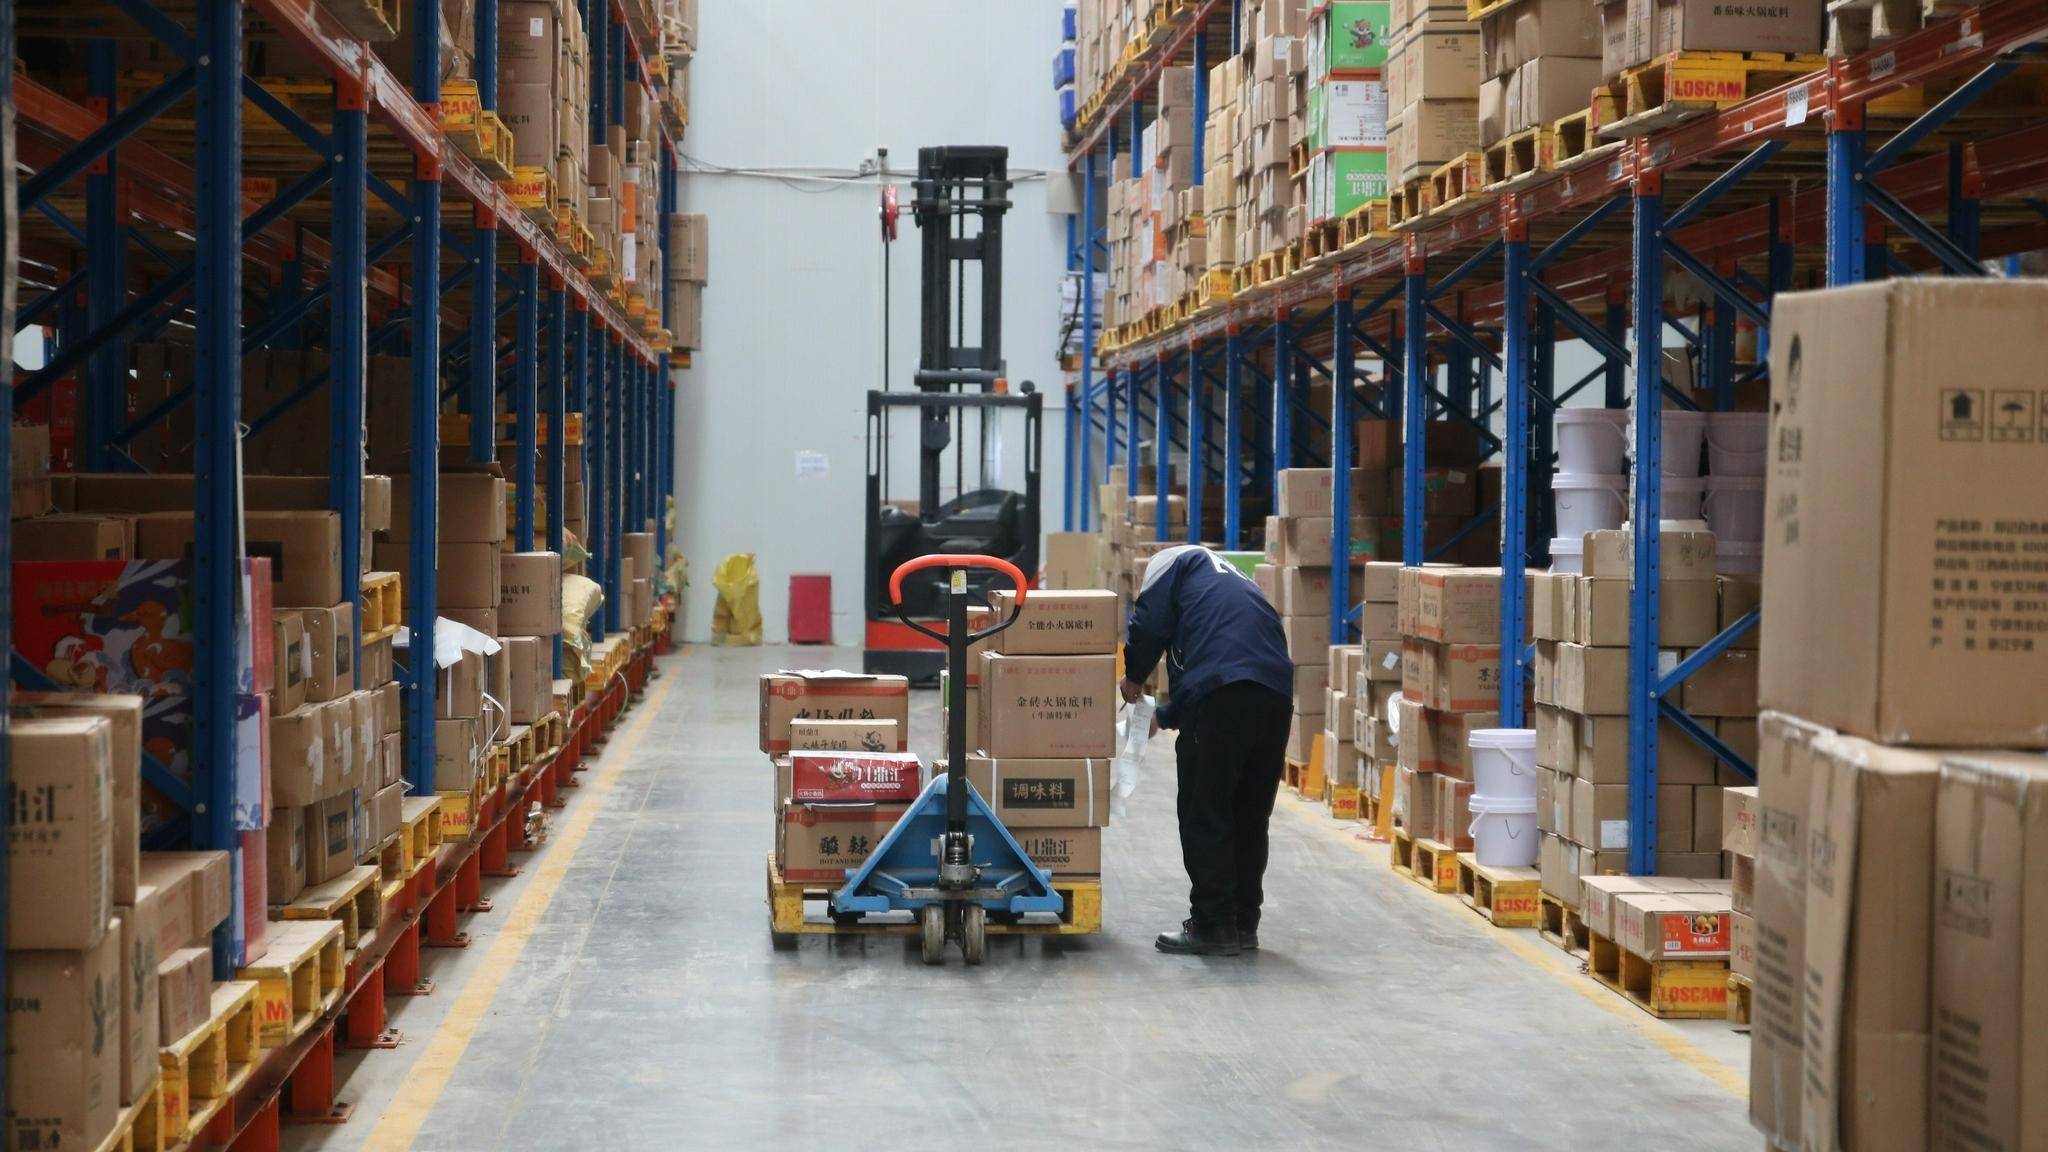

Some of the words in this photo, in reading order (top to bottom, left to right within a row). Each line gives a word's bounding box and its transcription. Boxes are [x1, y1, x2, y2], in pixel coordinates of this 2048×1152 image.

[1713, 5, 1789, 17] 番茄味火锅底料
[1673, 79, 1742, 98] LOSCAM
[1028, 620, 1093, 630] 全能小火锅底料
[1017, 696, 1093, 708] 金砖火锅底料
[1012, 783, 1065, 800] 调味料
[1660, 986, 1727, 1003] LOSCAM
